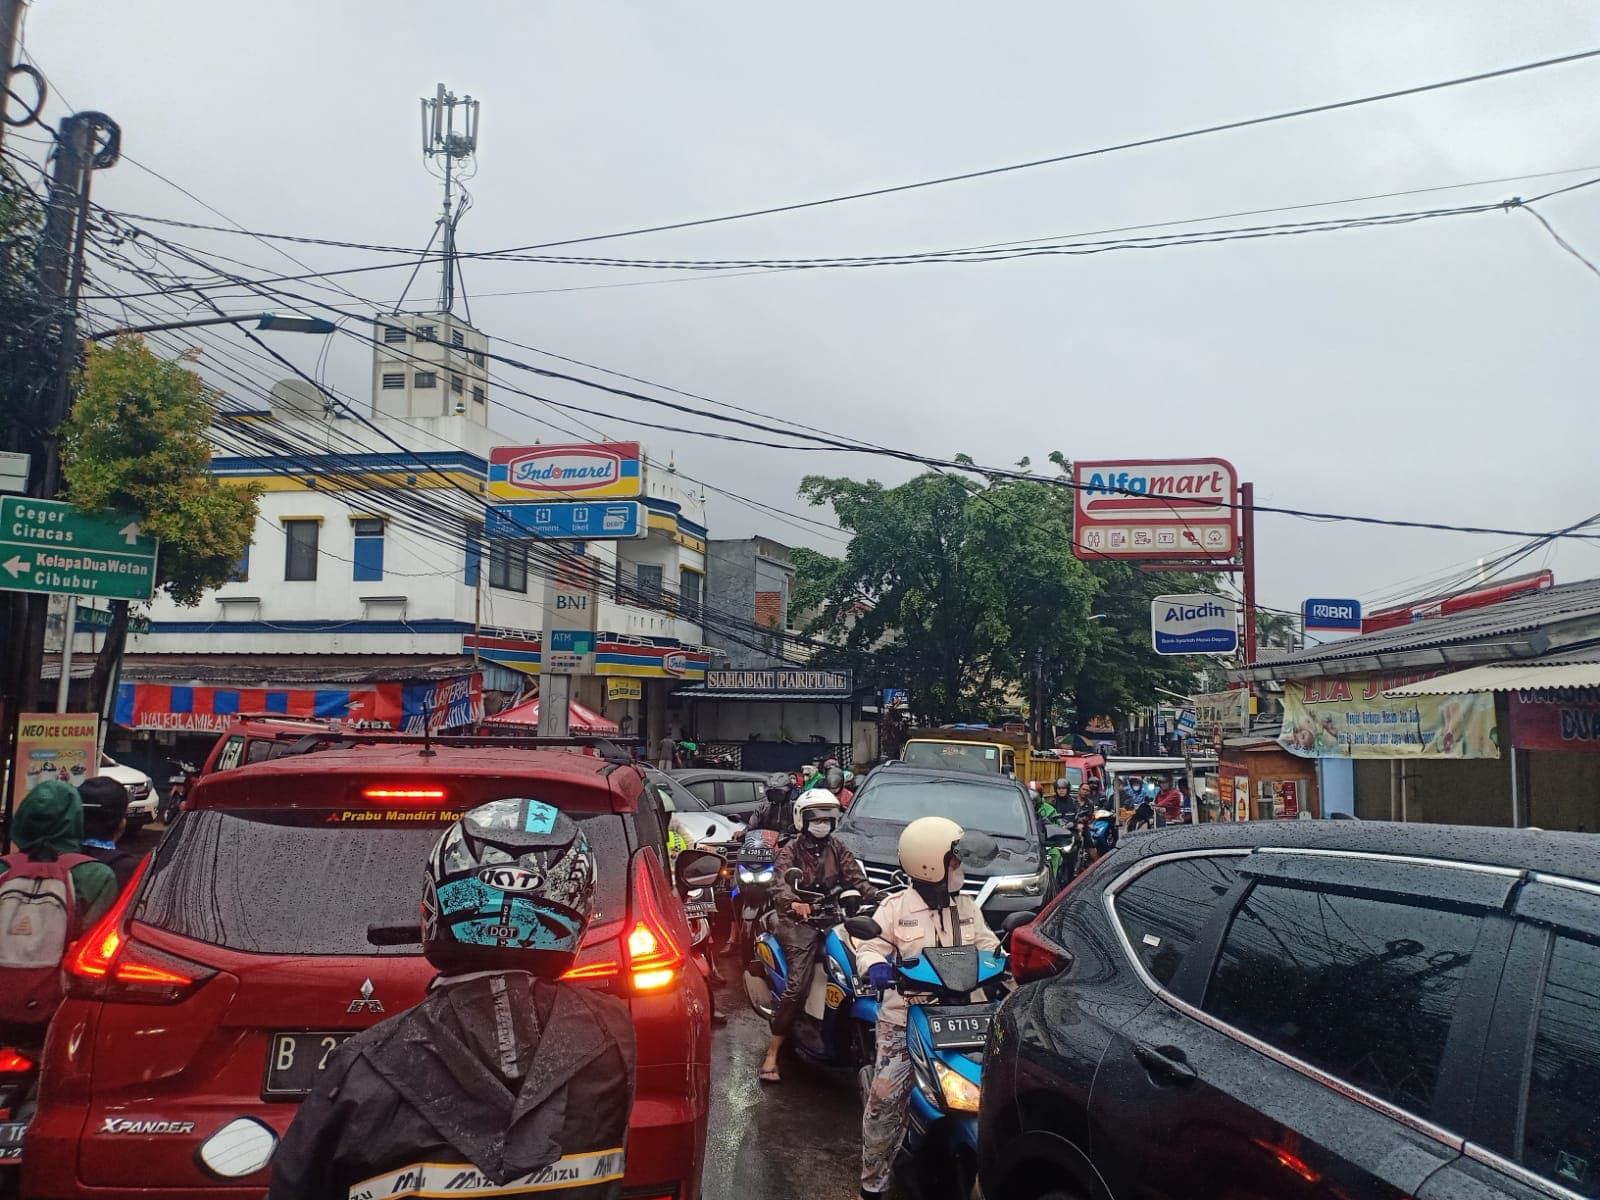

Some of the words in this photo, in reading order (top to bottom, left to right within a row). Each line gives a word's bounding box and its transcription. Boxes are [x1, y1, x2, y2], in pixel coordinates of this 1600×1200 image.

[515, 462, 612, 481] Indomaret
[1087, 471, 1224, 496] Alfamart
[14, 505, 65, 523] Ceger
[12, 523, 74, 542] Ciracas
[34, 571, 98, 589] Cibubur
[556, 595, 587, 610] BNI
[1164, 602, 1225, 622] Aladin
[1329, 606, 1353, 619] BRI
[553, 633, 572, 642] ATM
[709, 672, 774, 688] SAHABAT
[777, 672, 846, 689] PARFUME
[22, 725, 44, 737] NEO
[45, 726, 60, 737] ICE
[62, 726, 94, 737] CREAM
[342, 811, 382, 821] Prabu
[385, 810, 436, 821] Mandiri
[490, 927, 517, 937] DOT
[933, 1021, 941, 1033] B
[948, 1019, 979, 1031] 6719
[277, 1037, 296, 1070] B
[100, 1117, 195, 1134] XPANDER
